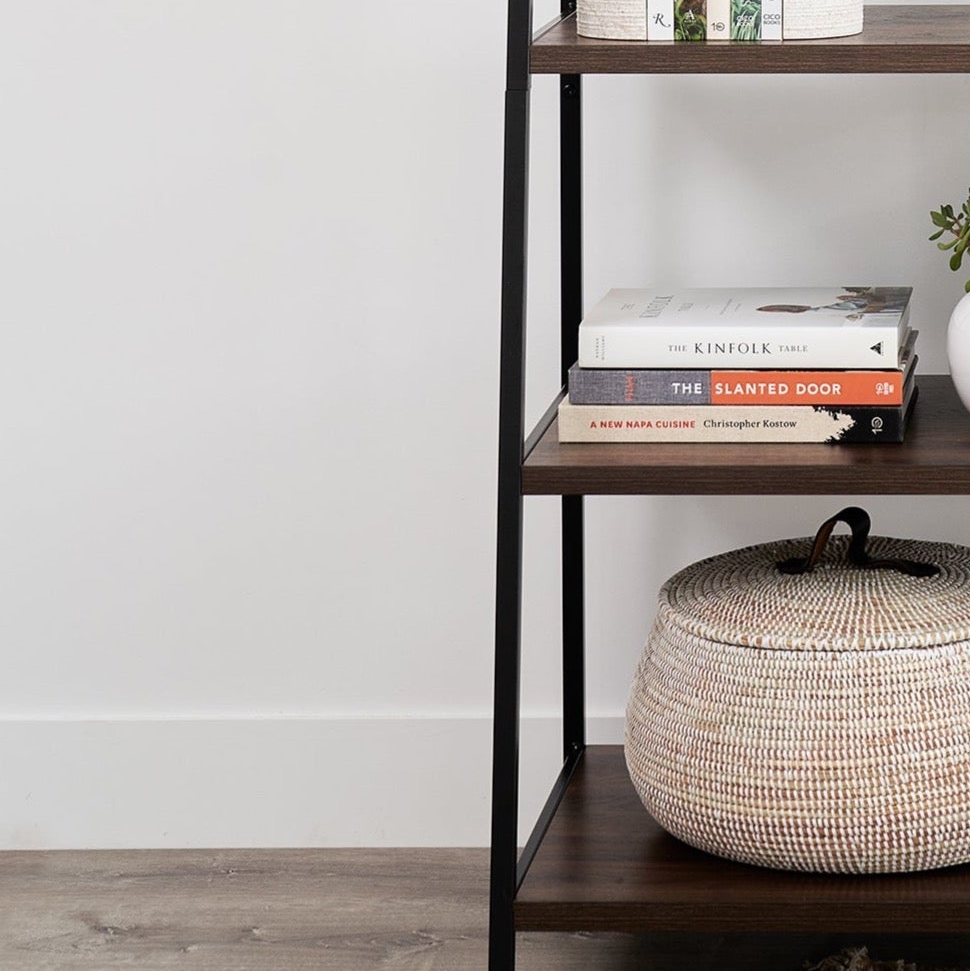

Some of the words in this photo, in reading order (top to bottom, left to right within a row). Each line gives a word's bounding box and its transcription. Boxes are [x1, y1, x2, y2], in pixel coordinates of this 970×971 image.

[668, 344, 688, 352] THE
[694, 342, 772, 354] KINFOLK
[671, 382, 703, 395] THE
[714, 382, 789, 396] SLANTED
[795, 383, 842, 396] DOOR
[589, 420, 597, 428] A
[600, 420, 624, 428] NEW
[626, 420, 652, 429] NAPA
[655, 420, 696, 429] CUISINE
[703, 419, 761, 430] Christopher
[763, 419, 797, 428] Kostow
